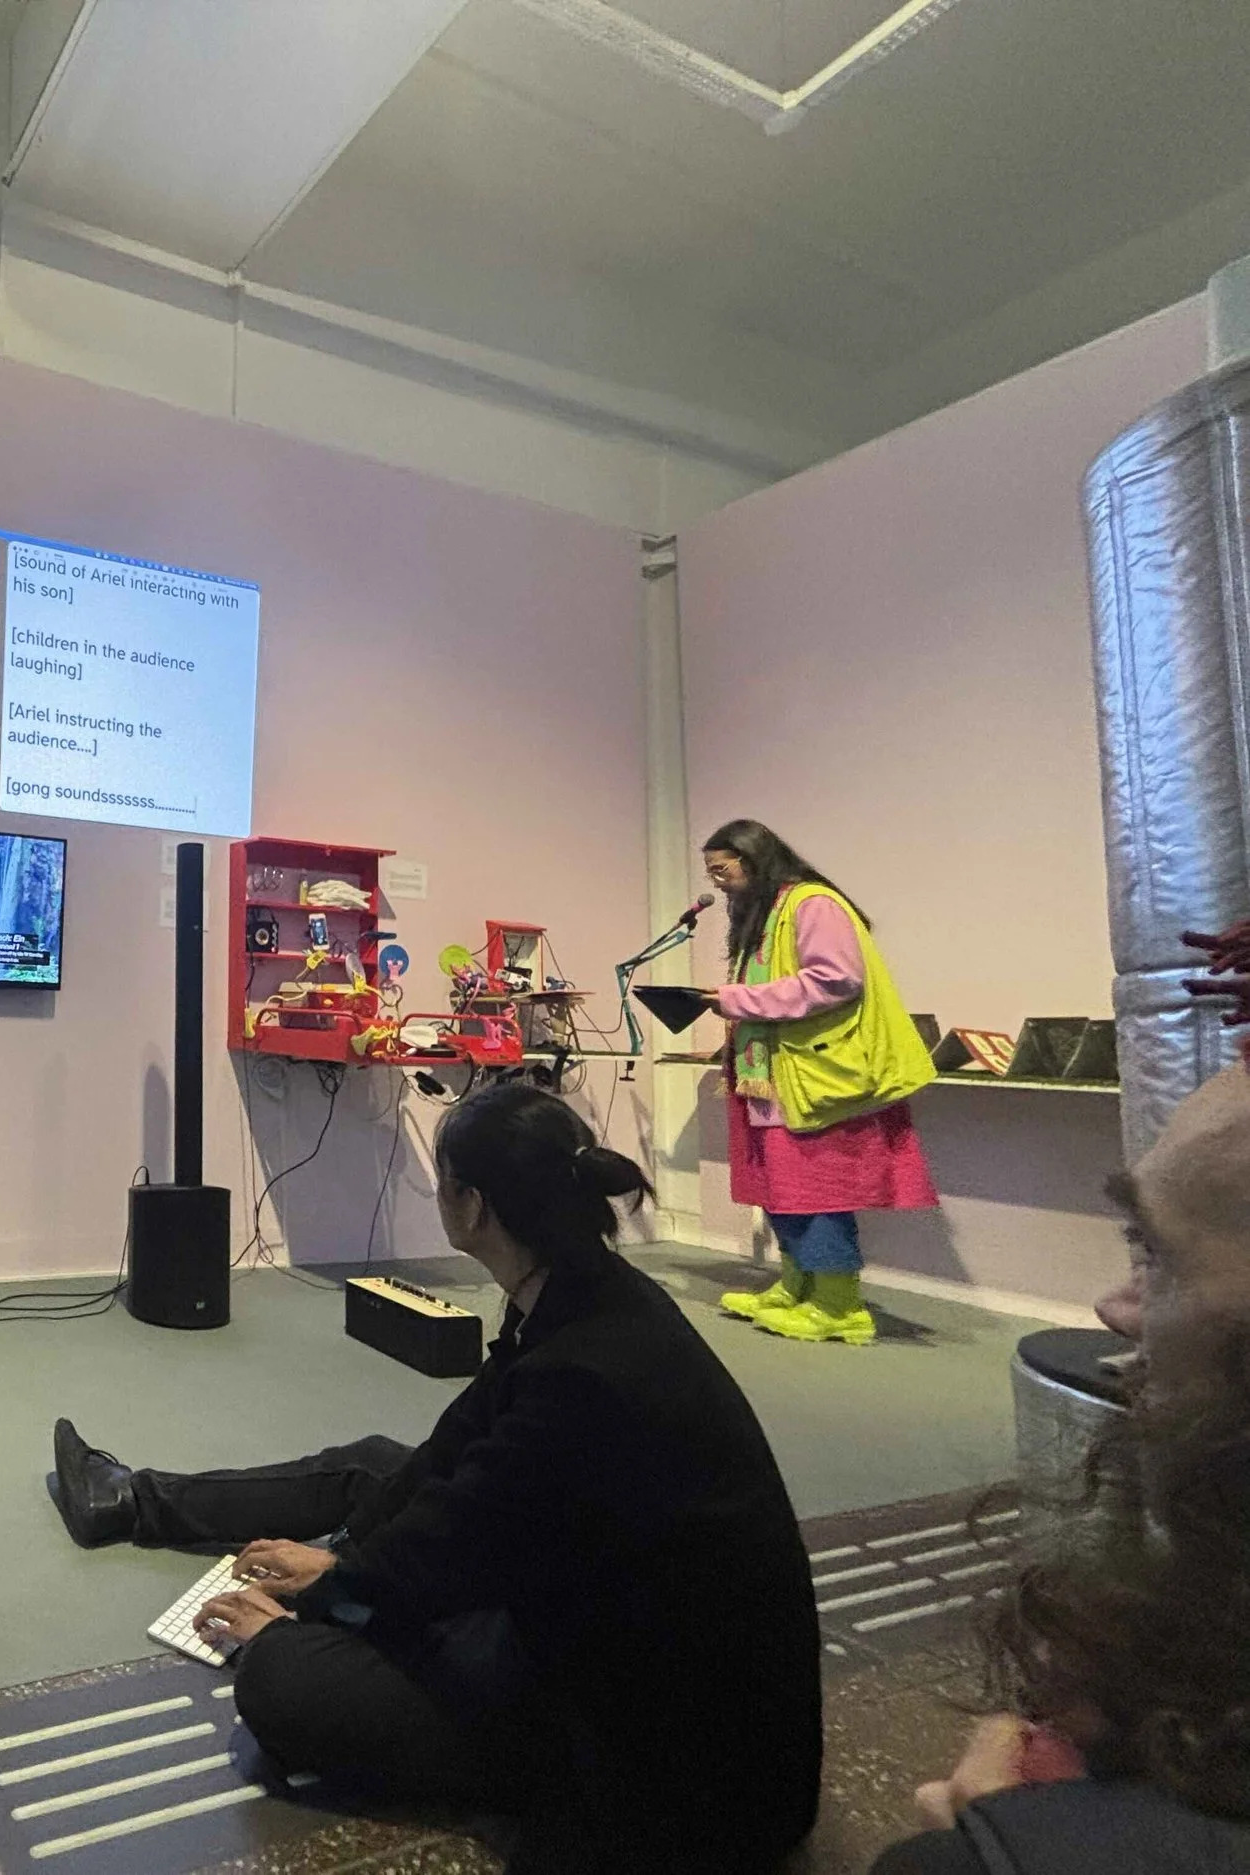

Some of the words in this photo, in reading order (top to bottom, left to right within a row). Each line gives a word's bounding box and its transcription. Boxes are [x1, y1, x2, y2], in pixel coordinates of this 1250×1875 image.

[13, 576, 36, 595] his
[41, 585, 74, 605] son]
[14, 551, 66, 575] [sound
[71, 565, 86, 579] of
[90, 568, 126, 587] Ariel
[130, 576, 206, 606] interacting
[210, 591, 240, 609] with
[12, 626, 79, 653] [children
[83, 639, 97, 656] in
[102, 643, 126, 660] the
[130, 651, 195, 672] audience
[11, 651, 82, 681] laughing]
[9, 702, 50, 723] [Ariel
[55, 708, 134, 738] instructing
[139, 721, 162, 738] the
[6, 776, 50, 800] [gong
[13, 934, 25, 943] Ein
